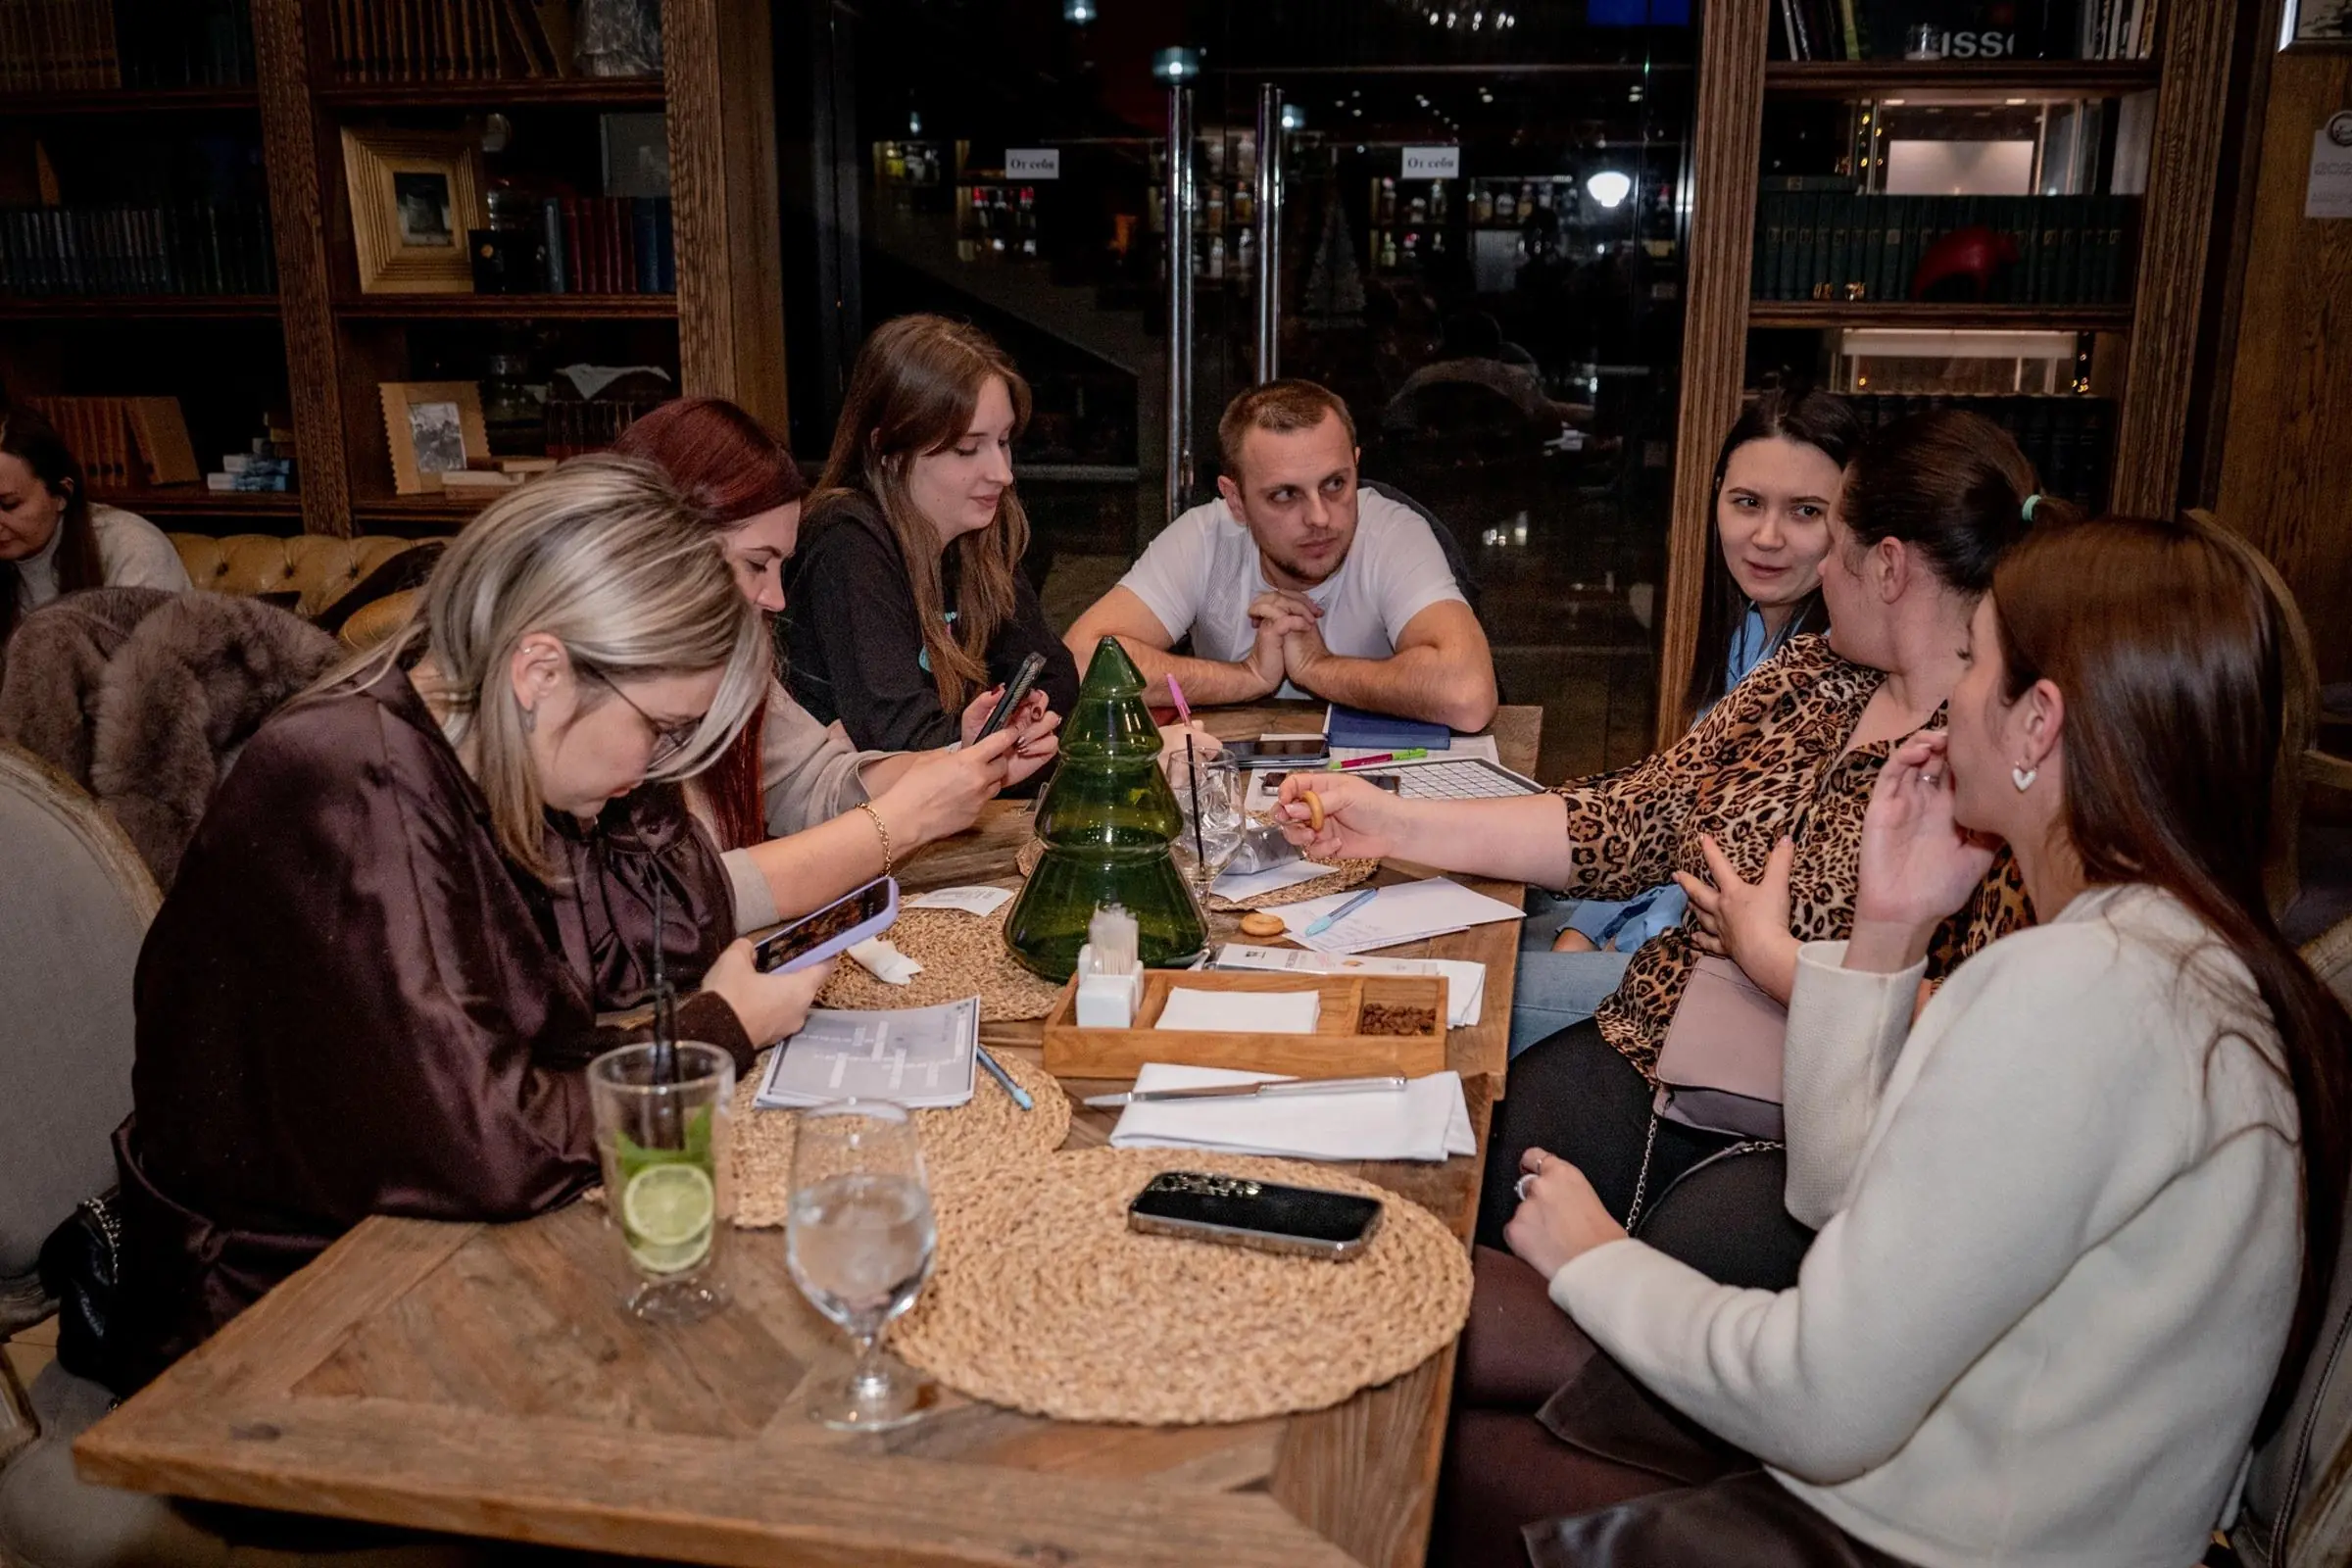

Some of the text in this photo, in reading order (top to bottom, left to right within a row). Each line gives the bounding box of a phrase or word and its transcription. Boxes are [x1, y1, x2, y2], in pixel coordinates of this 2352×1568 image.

[1010, 158, 1026, 170] От
[1407, 157, 1453, 169] От себя
